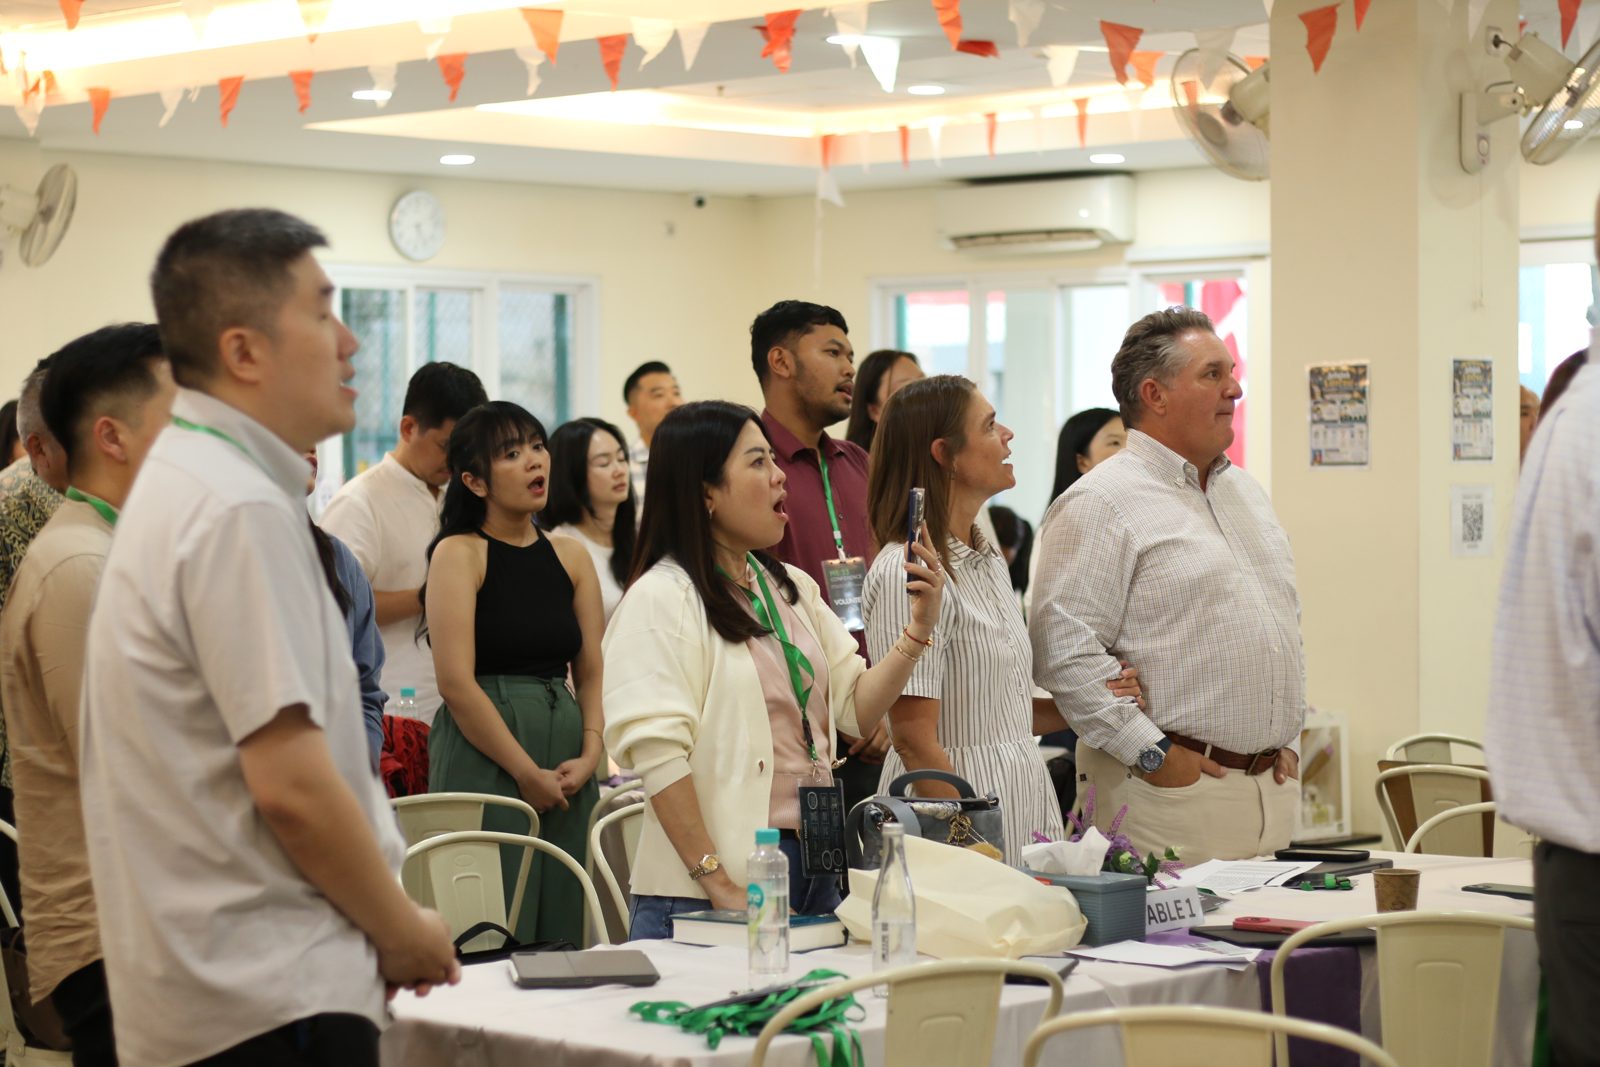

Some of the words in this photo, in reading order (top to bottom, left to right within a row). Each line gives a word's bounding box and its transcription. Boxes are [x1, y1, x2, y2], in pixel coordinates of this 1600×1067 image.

[834, 597, 862, 606] VOLUNTE
[1147, 900, 1185, 925] ABLE
[1185, 898, 1196, 917] 1
